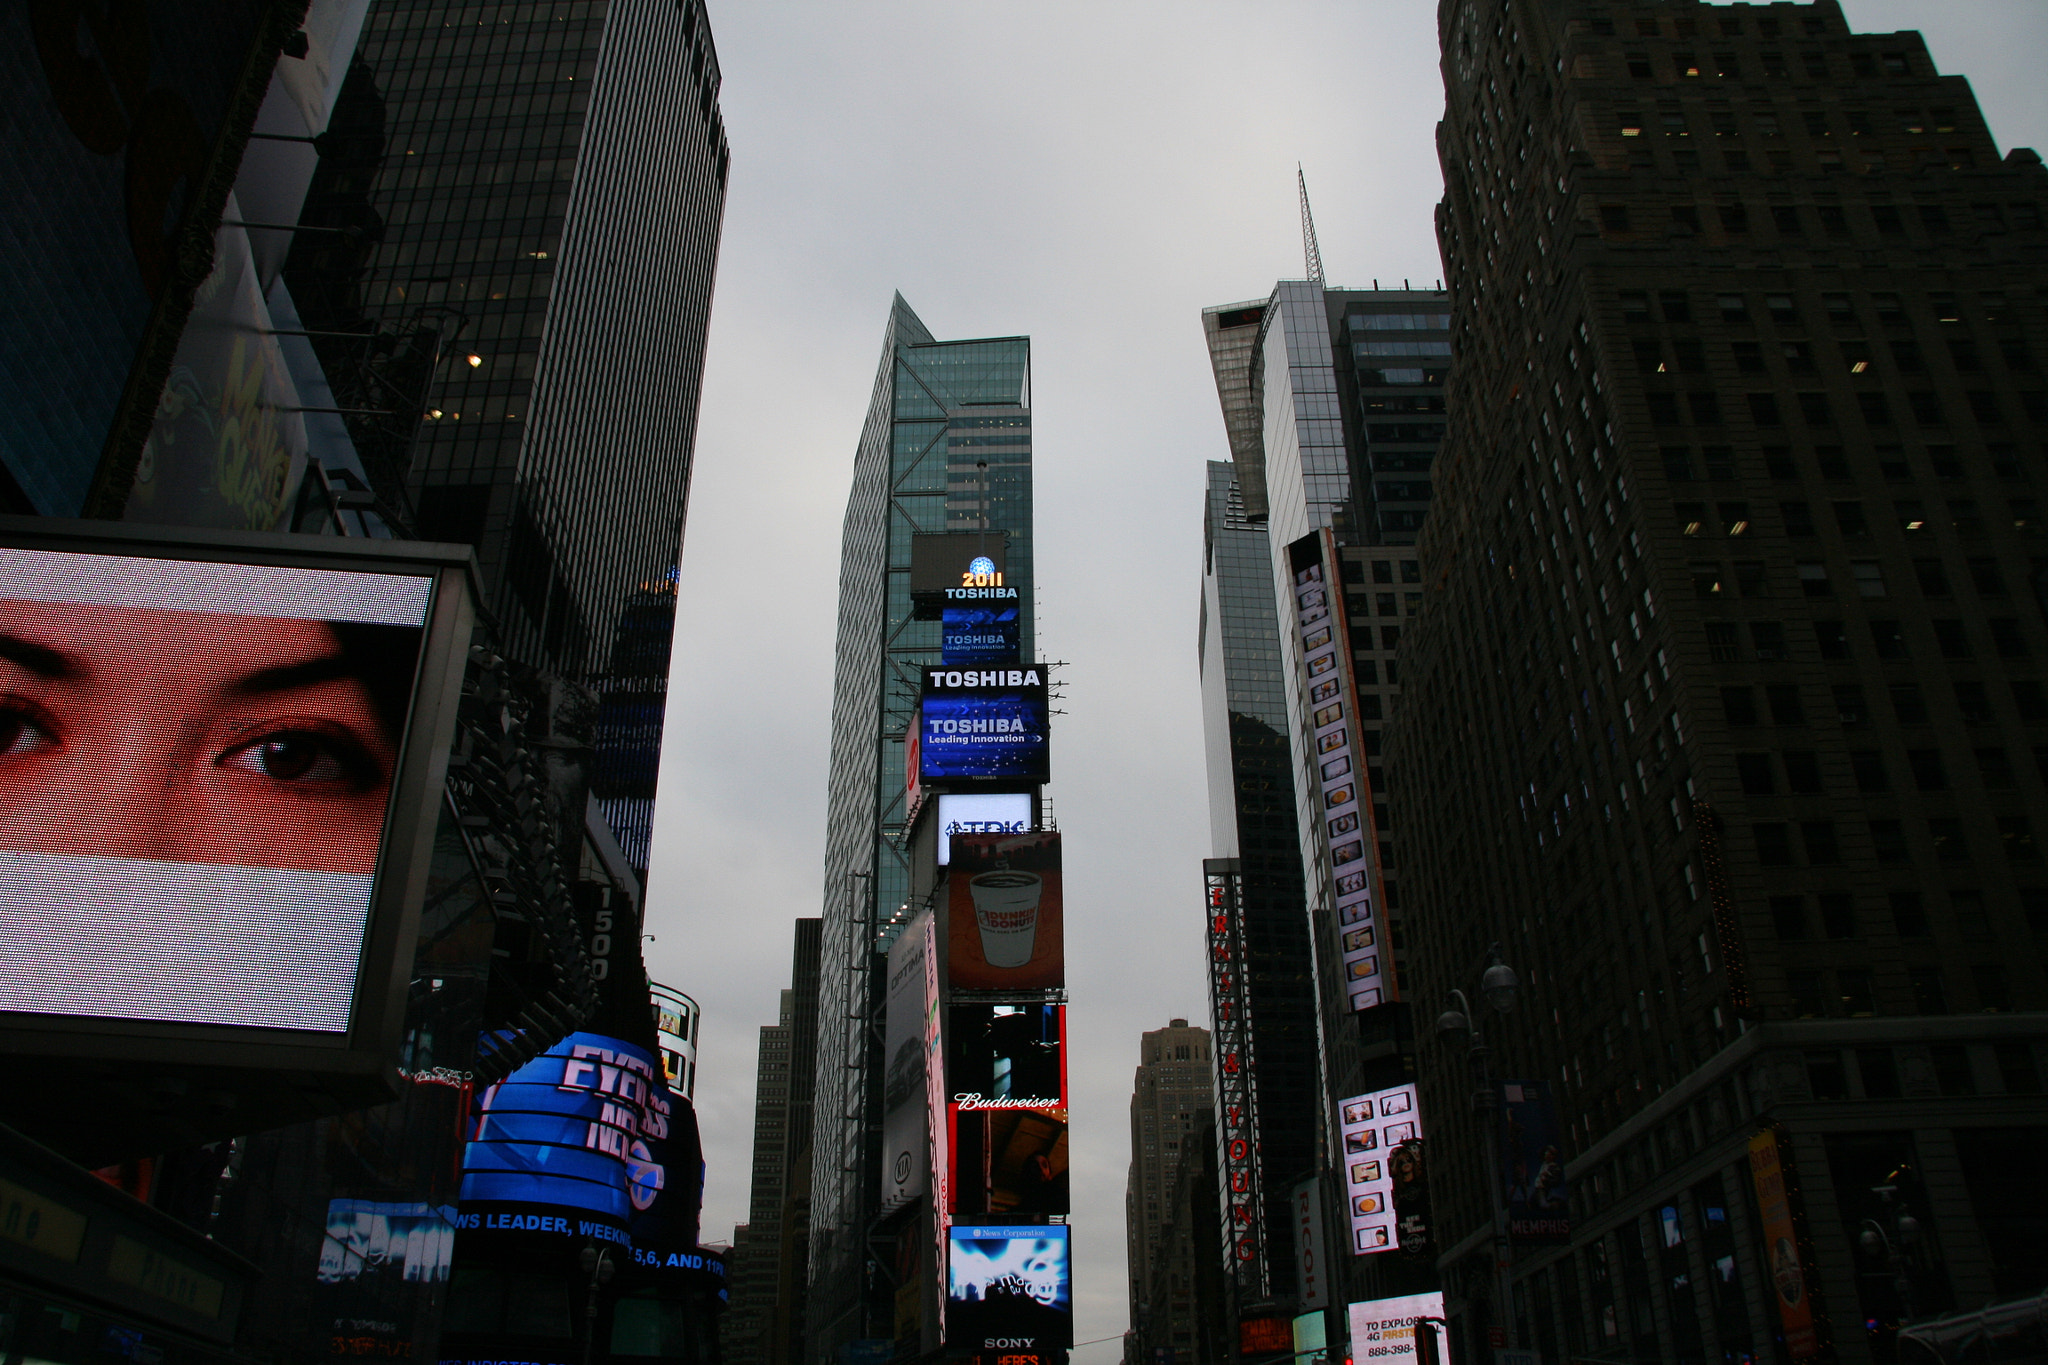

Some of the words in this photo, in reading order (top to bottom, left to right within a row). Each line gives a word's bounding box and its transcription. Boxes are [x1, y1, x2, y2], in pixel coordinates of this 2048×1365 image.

[962, 572, 1003, 587] 2011
[945, 587, 1018, 599] TOSHIBA
[945, 635, 1005, 645] TOSHIBA
[930, 670, 1041, 688] TOSHIBA
[930, 718, 1025, 734] TOSHIBA
[929, 736, 969, 745] Leading
[971, 735, 1025, 743] Innovation
[991, 916, 1034, 928] DONUTS
[591, 887, 614, 981] 1500
[1211, 888, 1237, 1021] ERNST
[891, 949, 924, 990] OPTIMA
[1223, 1053, 1240, 1075] &
[954, 1093, 1060, 1110] Budweiser
[1227, 1105, 1255, 1262] YOUNG
[486, 1213, 573, 1237] LEADER,
[982, 1228, 1001, 1237] News
[1003, 1228, 1046, 1238] Corporation
[1512, 1218, 1570, 1236] MEMPHIS
[1299, 1191, 1316, 1299] RICOH
[634, 1247, 661, 1268] 5,6,
[665, 1252, 703, 1269] AND
[1366, 1321, 1379, 1331] TO
[984, 1338, 1036, 1349] SONY
[1366, 1331, 1380, 1342] 4G
[1368, 1344, 1417, 1357] 888-398-
